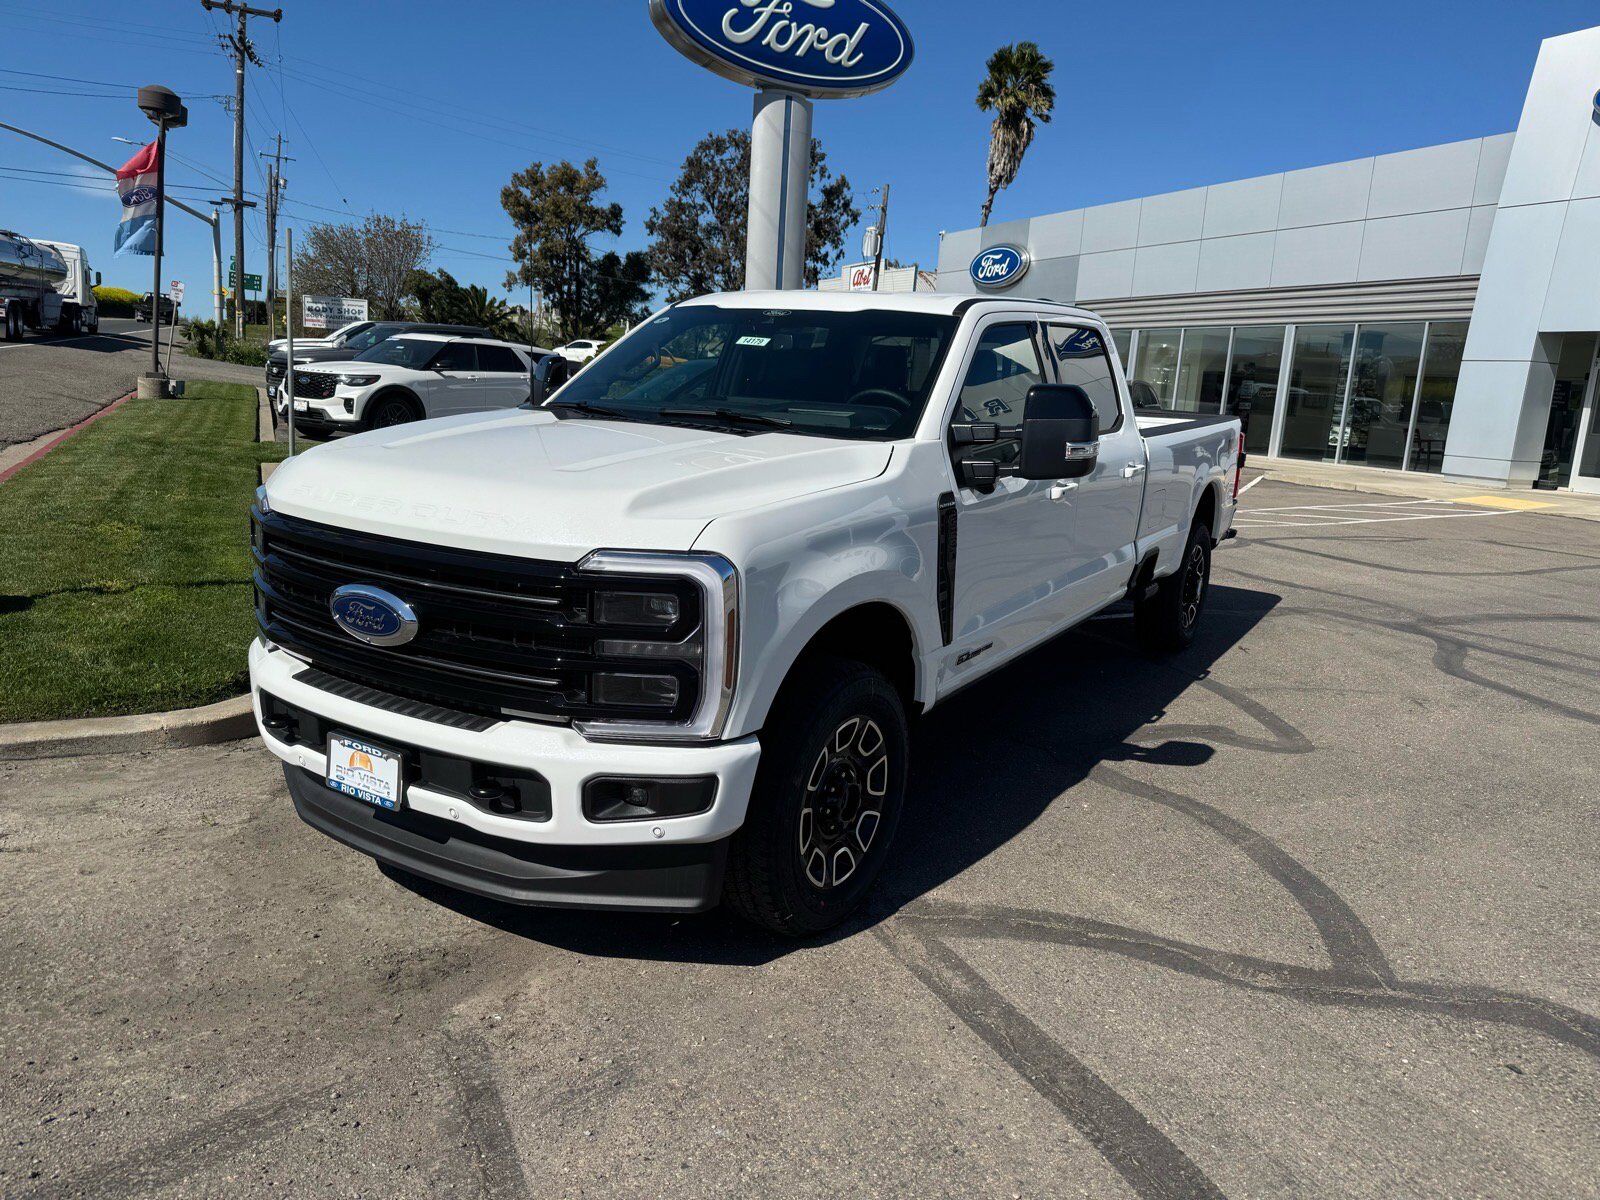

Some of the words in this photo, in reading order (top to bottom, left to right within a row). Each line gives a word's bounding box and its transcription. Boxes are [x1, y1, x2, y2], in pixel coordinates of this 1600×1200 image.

[722, 0, 870, 68] Ford
[978, 254, 1011, 279] Ford
[307, 305, 334, 314] BODY
[337, 307, 364, 316] SHOP
[345, 600, 385, 631] Ford
[343, 739, 382, 757] FORD
[341, 783, 355, 795] RIO
[358, 789, 382, 805] VISTA
